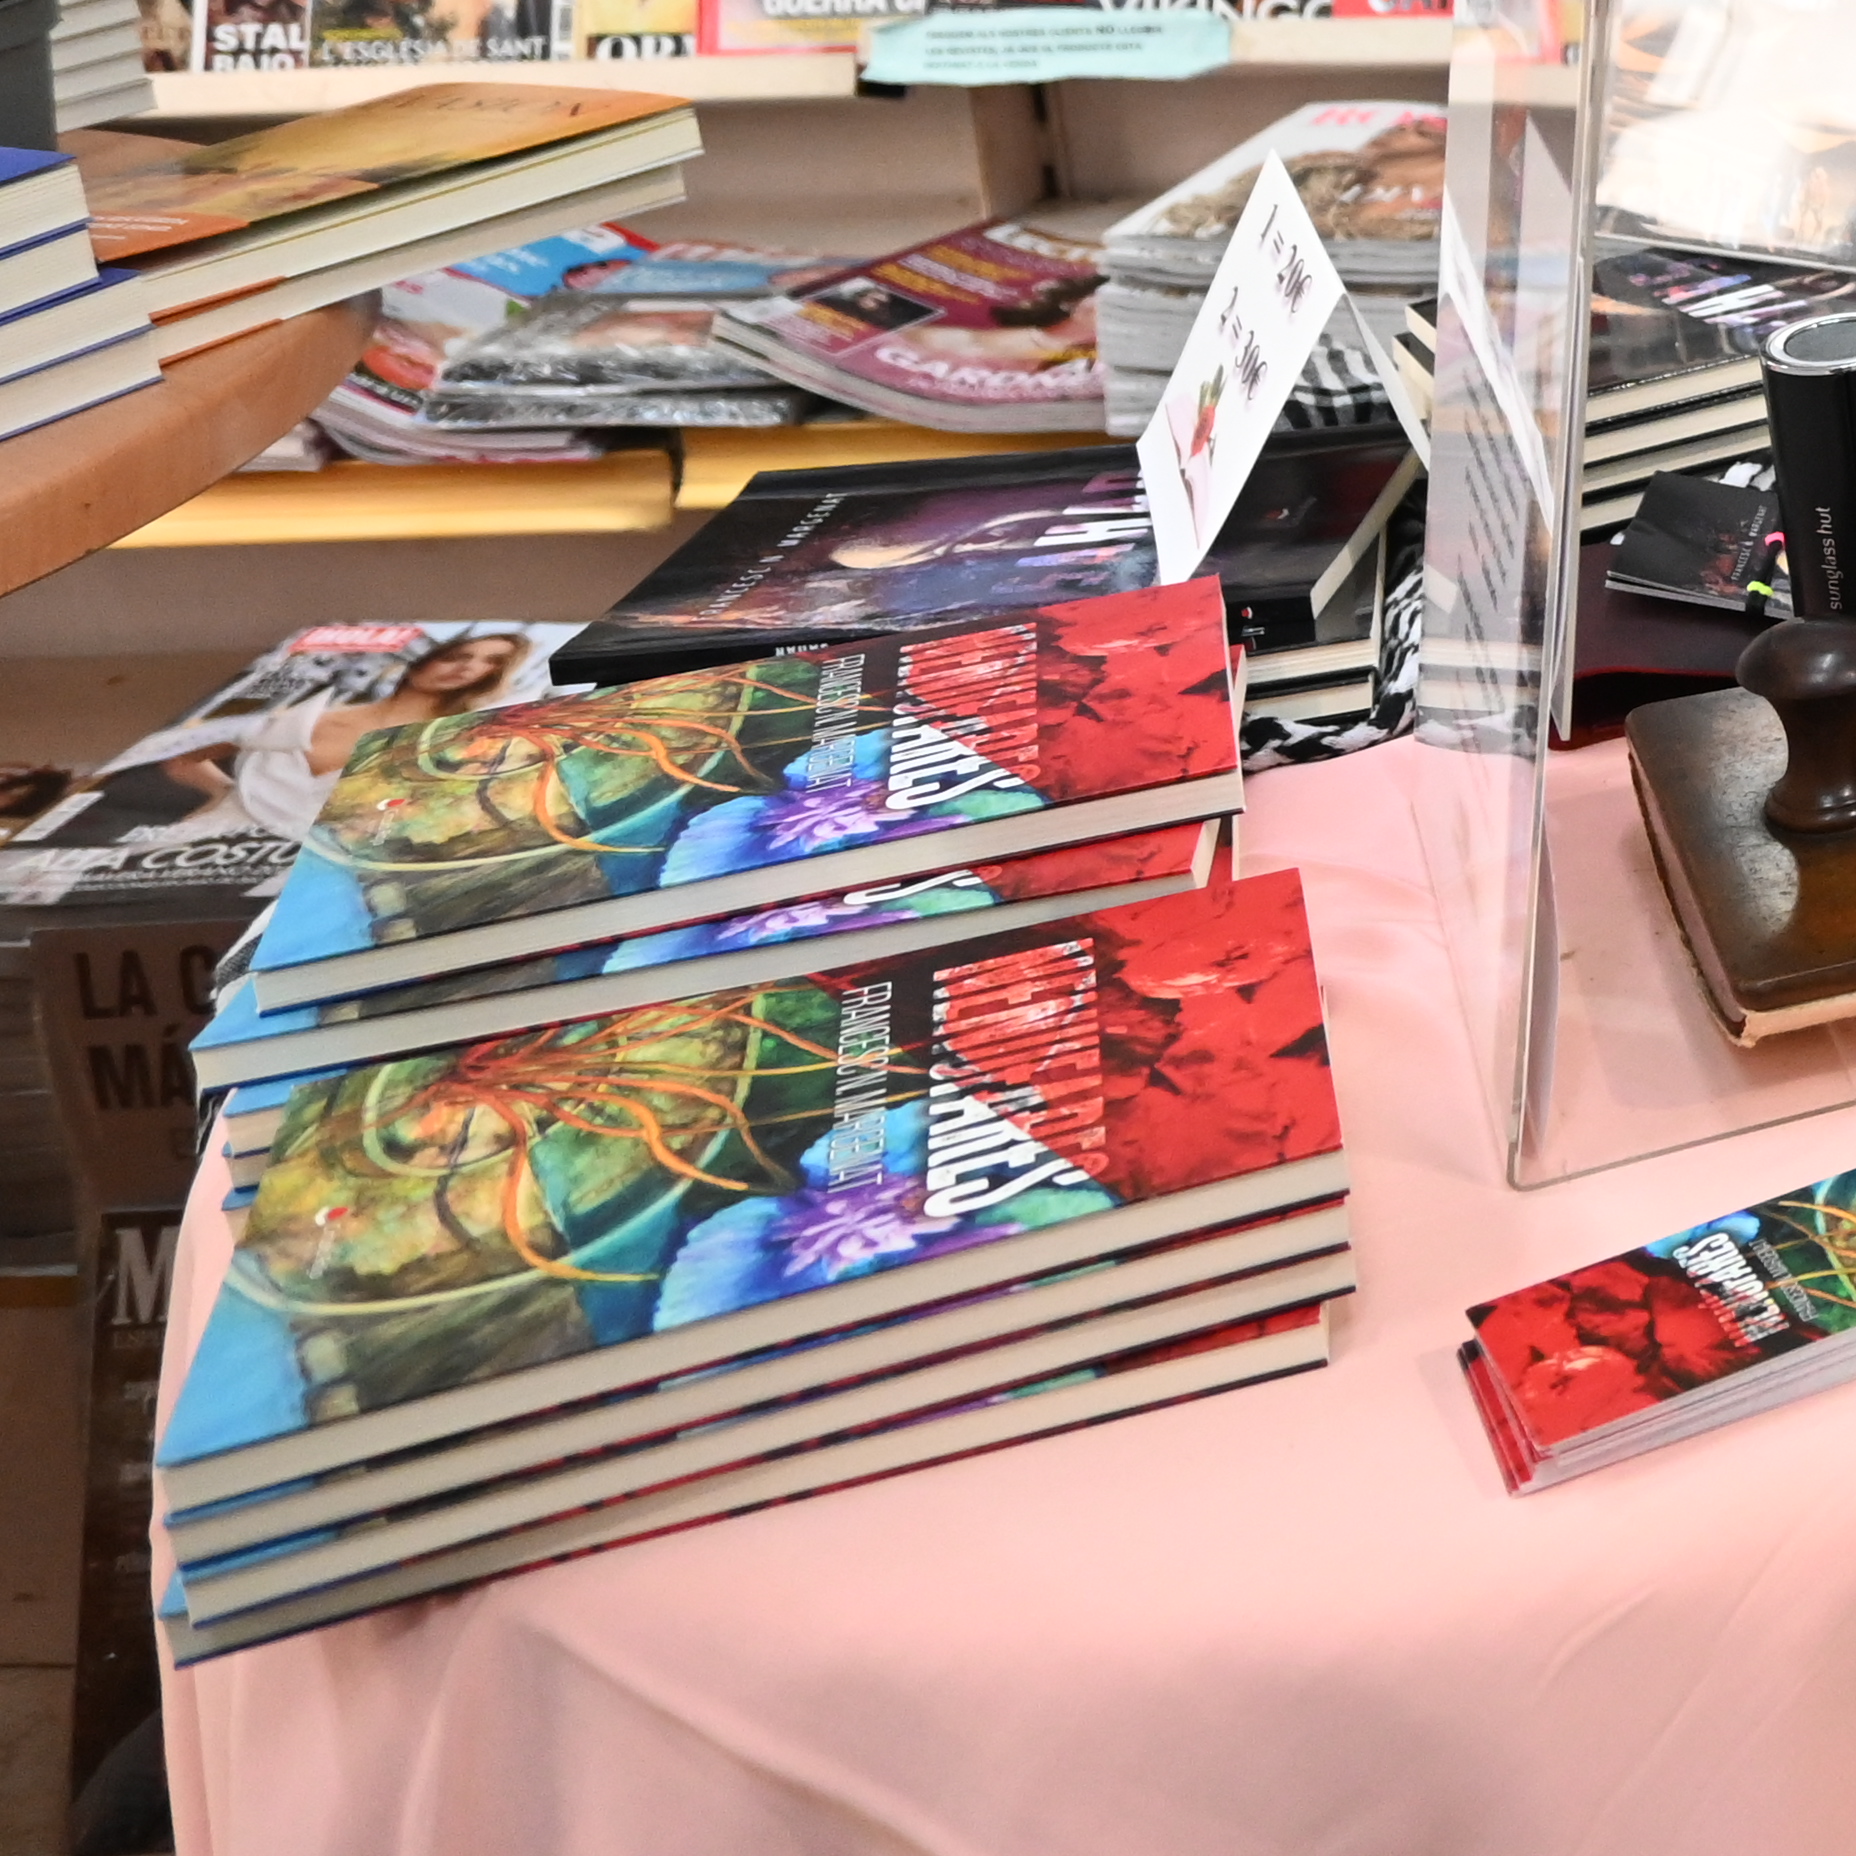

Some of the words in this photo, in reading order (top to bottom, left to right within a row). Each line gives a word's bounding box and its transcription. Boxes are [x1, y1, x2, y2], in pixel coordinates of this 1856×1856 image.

[1817, 505, 1831, 532] hut
[1821, 538, 1843, 610] sunglass
[819, 653, 865, 714] FRANCESC
[808, 721, 857, 791] MARGENAT
[74, 952, 155, 1020] LA
[837, 981, 893, 1076] FRANCESC
[827, 1088, 888, 1195] MARGENAT
